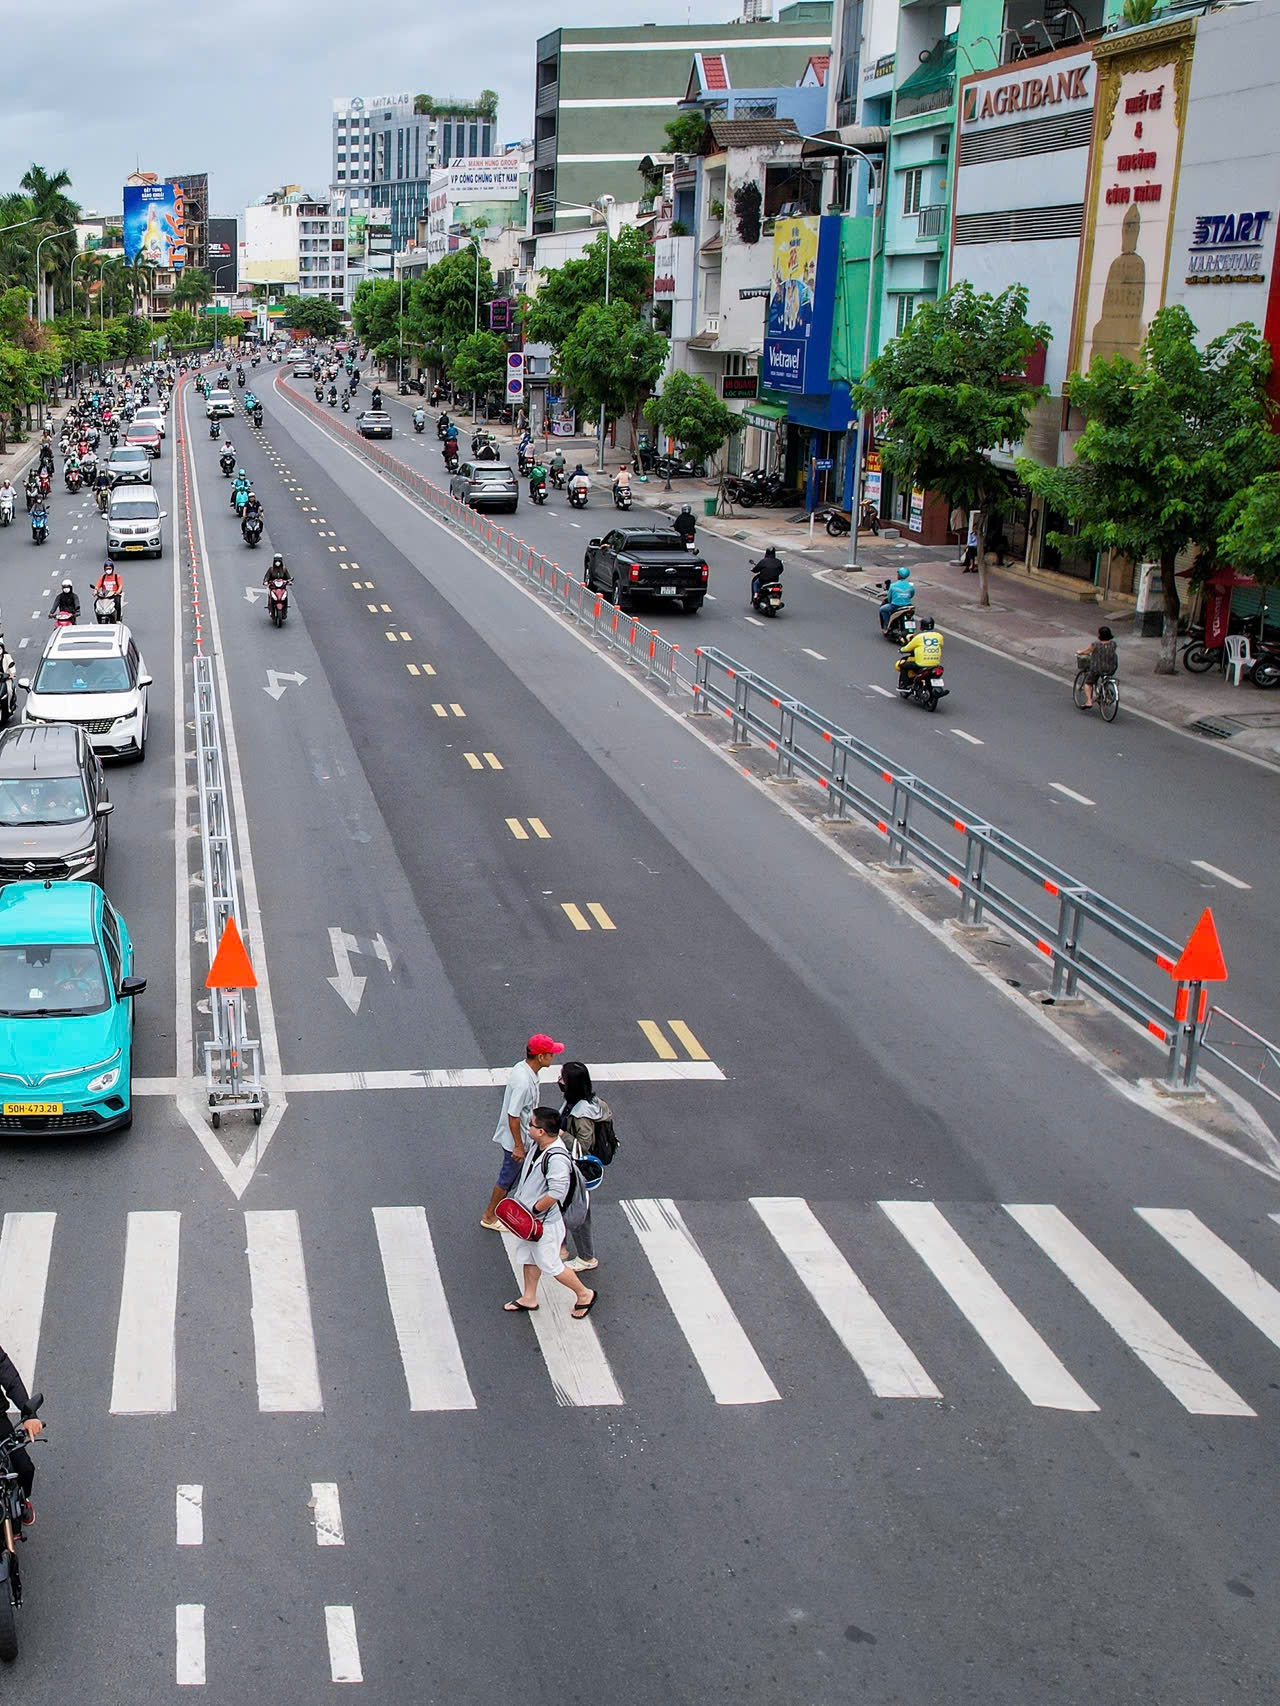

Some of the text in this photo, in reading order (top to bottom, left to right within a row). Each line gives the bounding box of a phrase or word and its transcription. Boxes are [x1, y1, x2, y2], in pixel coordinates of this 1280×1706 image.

[980, 65, 1090, 119] AGRIBANK
[1134, 121, 1143, 139] &
[451, 174, 459, 184] VP
[506, 173, 518, 183] NAM
[1192, 211, 1273, 244] START
[1188, 252, 1263, 273] MARKETING
[769, 344, 800, 369] Vietravel
[923, 635, 939, 646] be
